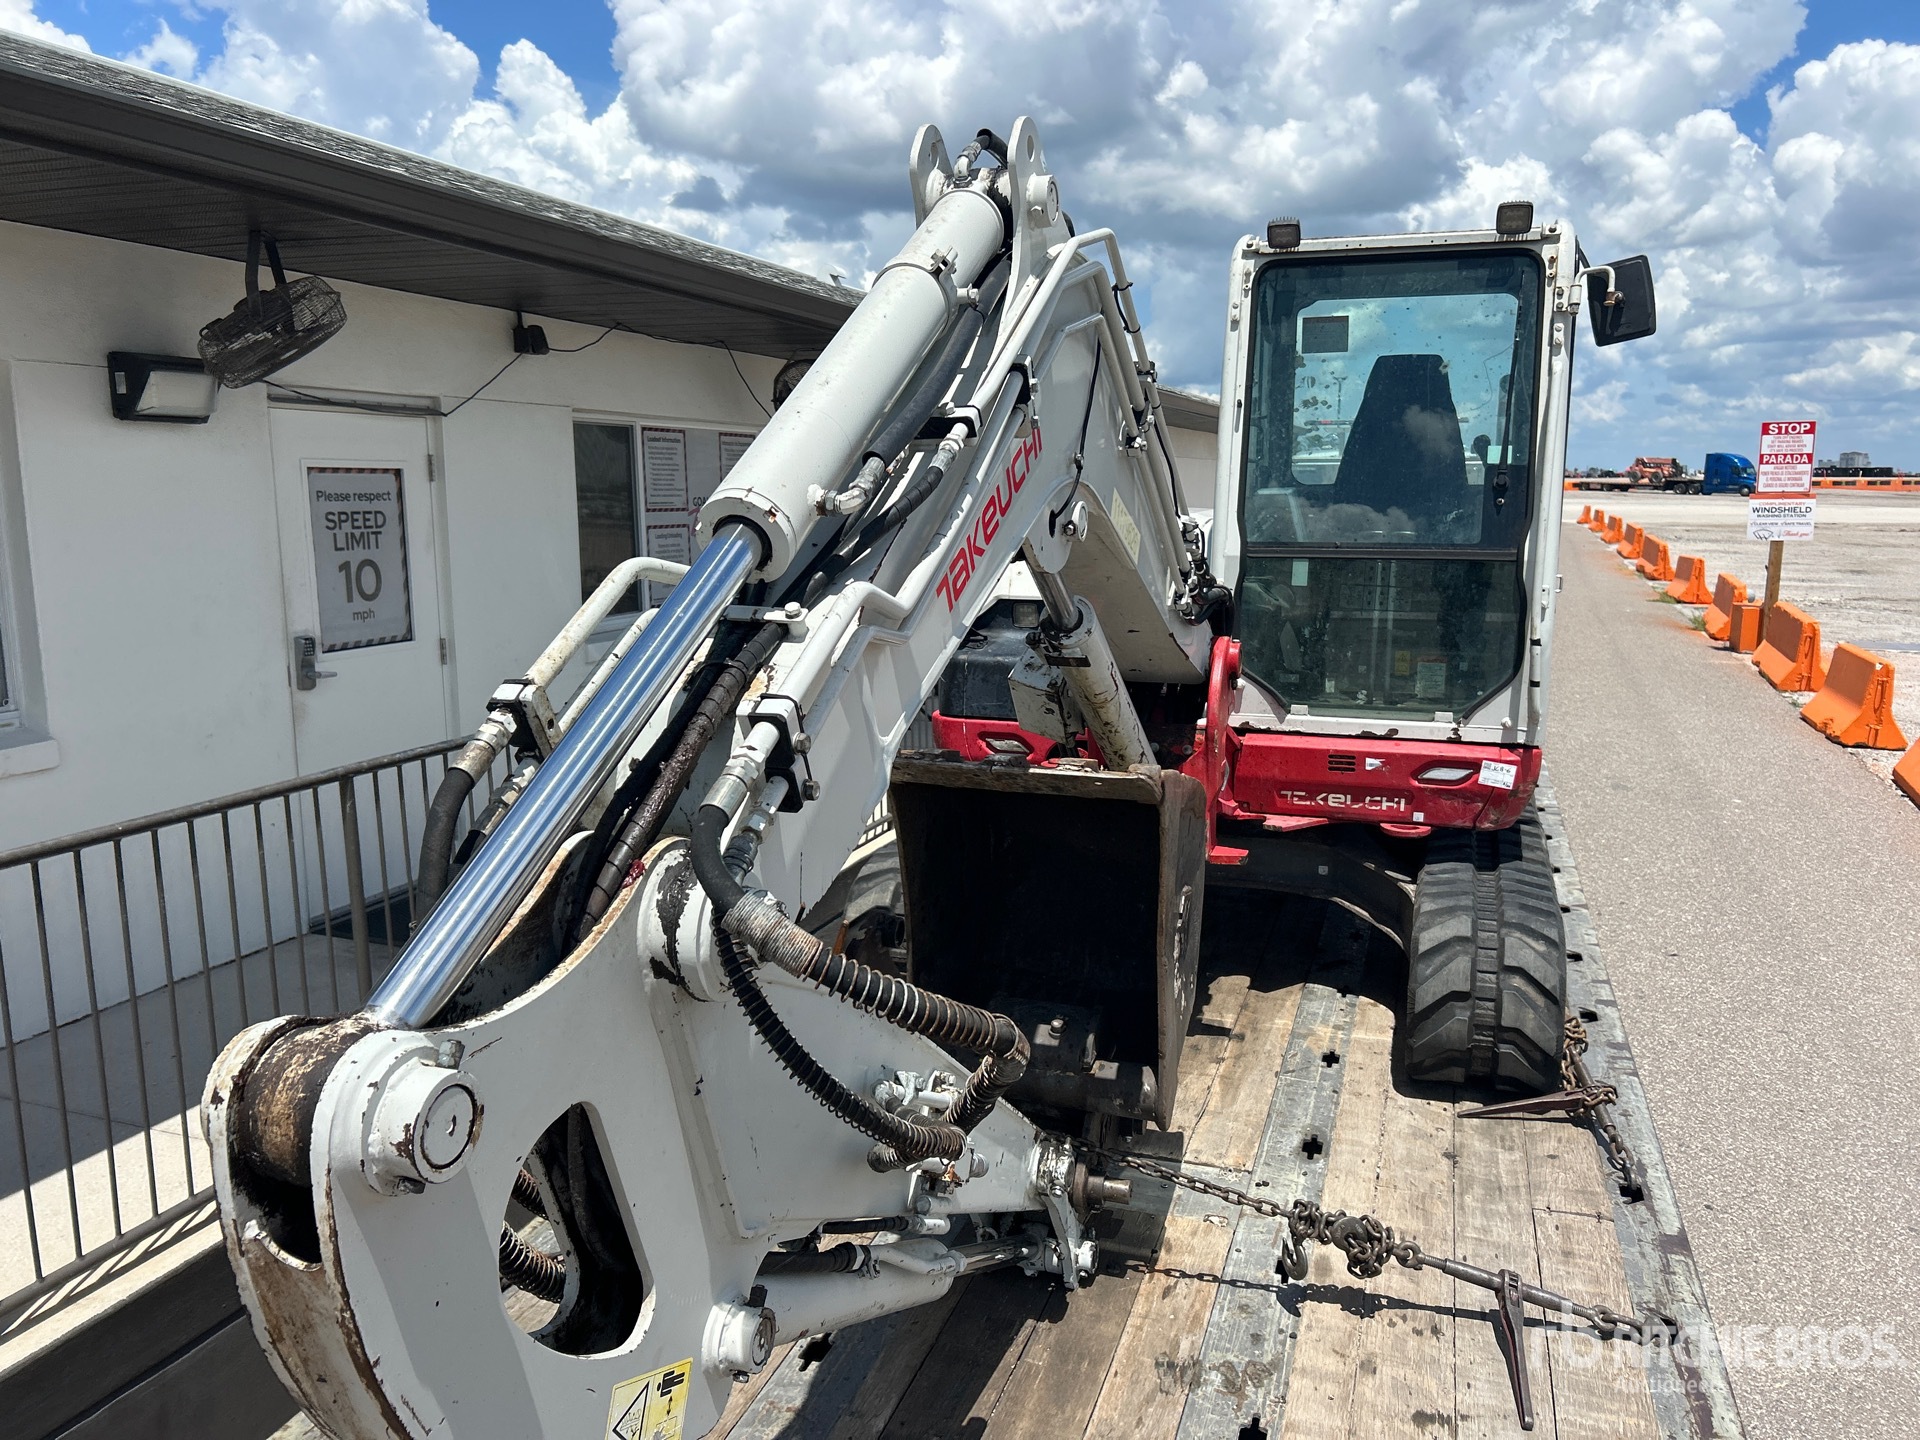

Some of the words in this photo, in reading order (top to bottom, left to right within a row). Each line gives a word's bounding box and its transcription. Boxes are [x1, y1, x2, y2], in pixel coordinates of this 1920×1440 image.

[1768, 423, 1811, 435] STOP
[1763, 454, 1809, 464] PARADA
[315, 490, 352, 502] Please
[353, 490, 392, 504] respect
[325, 510, 387, 531] SPEED
[333, 531, 383, 551] LIMIT
[338, 558, 383, 604] 10
[352, 608, 376, 623] mph
